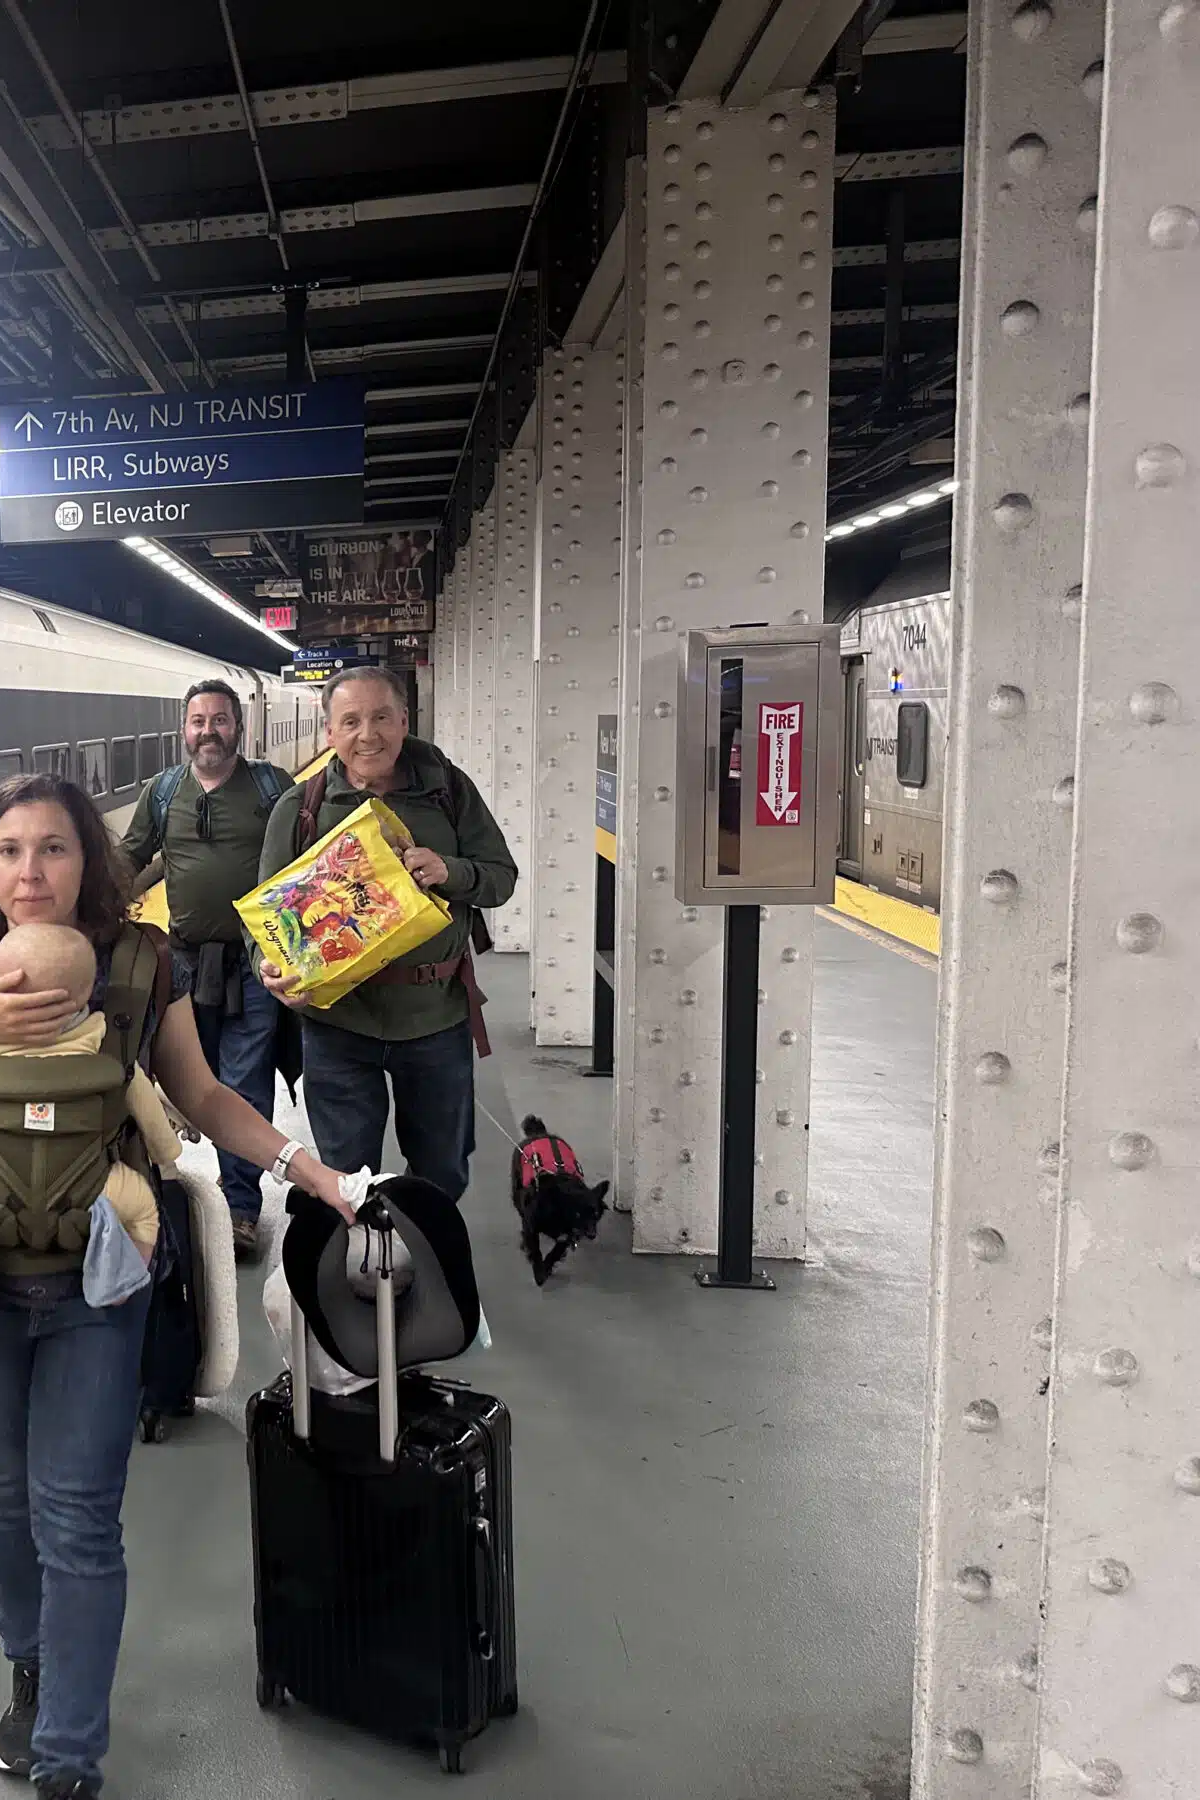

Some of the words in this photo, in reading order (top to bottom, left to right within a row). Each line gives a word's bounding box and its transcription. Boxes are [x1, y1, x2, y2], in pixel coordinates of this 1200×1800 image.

[52, 411, 94, 435] 7th
[104, 407, 139, 434] Av,
[150, 403, 184, 428] NJ
[194, 393, 307, 425] TRANSIT
[53, 456, 113, 482] LIRR,
[123, 451, 230, 480] Subways
[92, 500, 191, 526] Elevator
[309, 541, 380, 557] BOURBON
[309, 568, 324, 581] IS
[328, 566, 343, 580] IN
[310, 590, 337, 604] THE
[342, 588, 372, 602] AIR.
[265, 607, 292, 628] EXIT
[902, 622, 927, 651] 7044
[766, 713, 796, 730] FIRE
[774, 732, 785, 813] EXTINGUISHER
[263, 920, 293, 966] Wegmans
